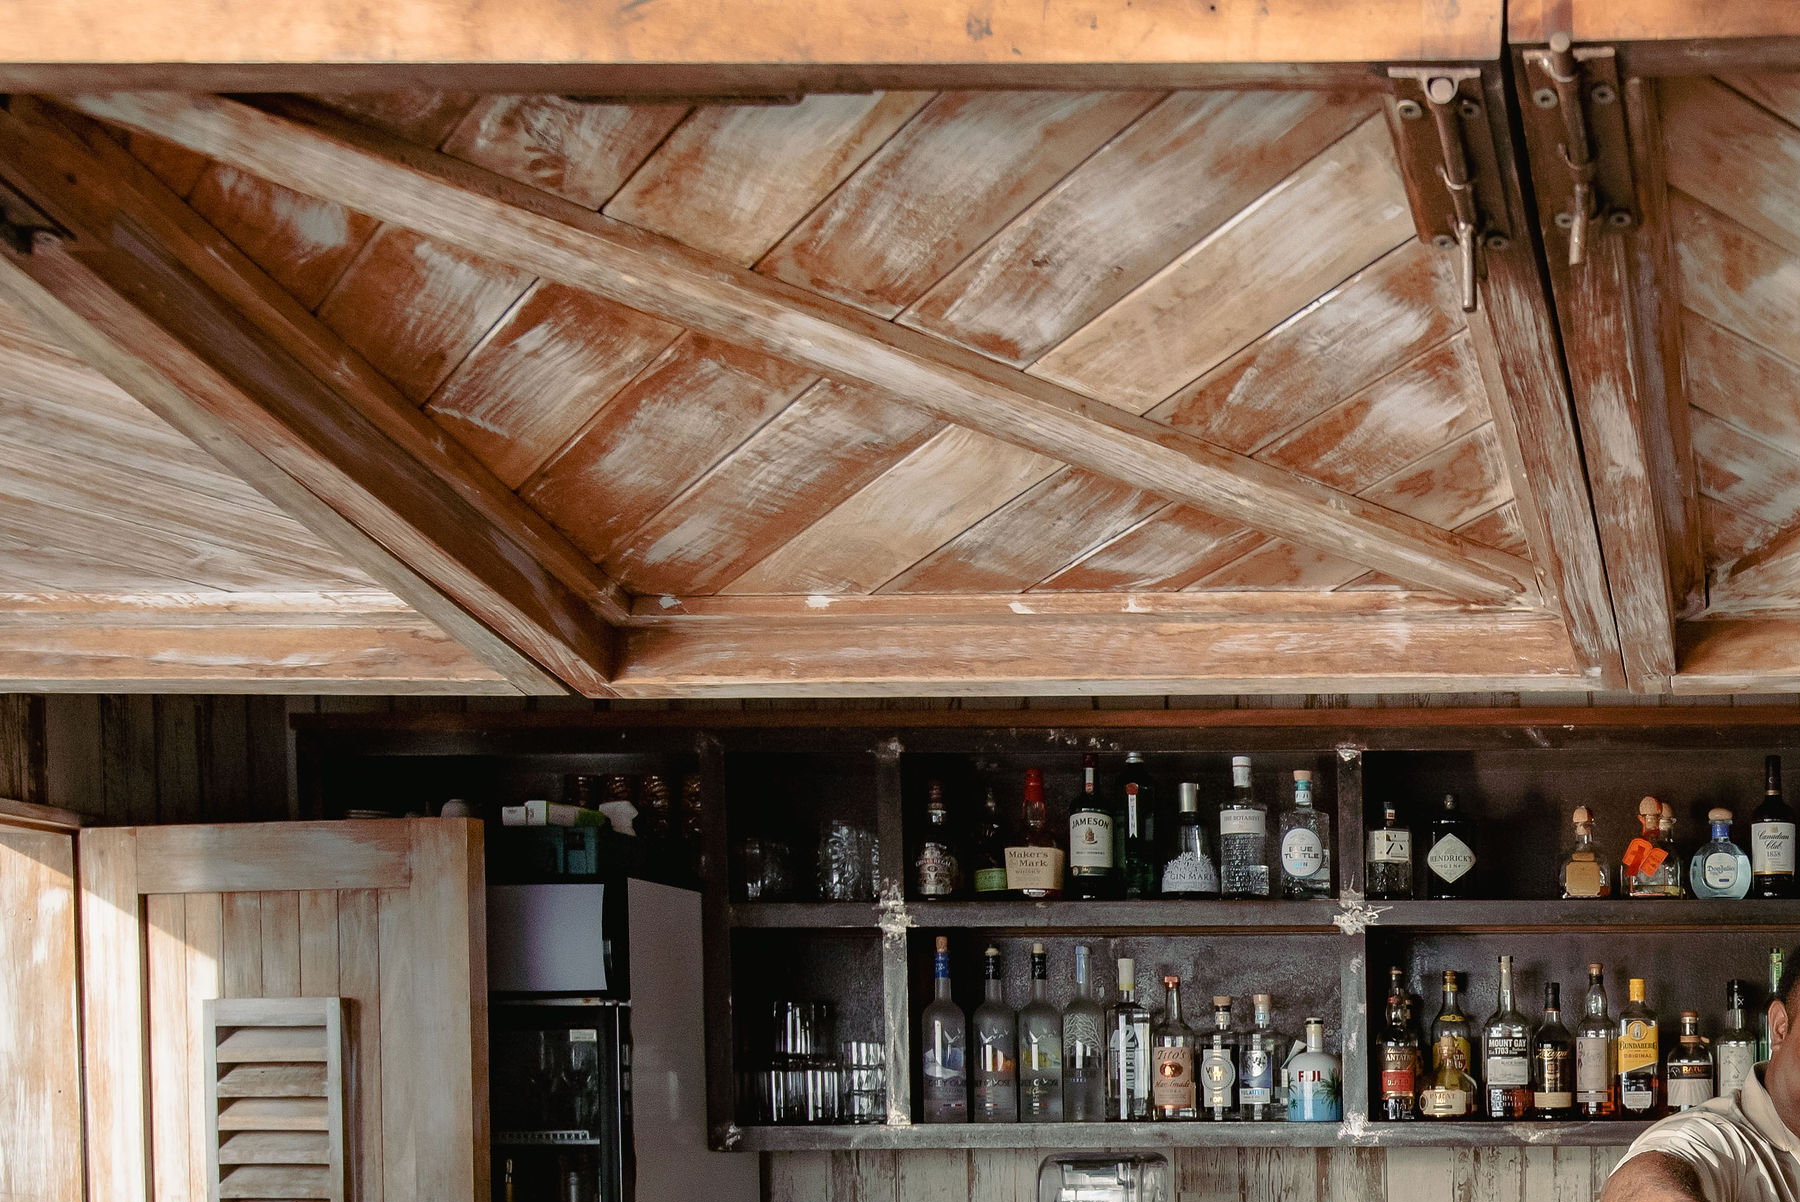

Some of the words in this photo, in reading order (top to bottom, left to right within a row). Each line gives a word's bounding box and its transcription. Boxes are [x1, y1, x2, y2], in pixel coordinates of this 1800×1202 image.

[1071, 817, 1110, 830] JAMESON
[1757, 830, 1790, 840] Canadian
[1764, 841, 1784, 850] Club
[1009, 851, 1049, 859] Maker's
[1018, 859, 1049, 868] Mark
[1169, 873, 1187, 881] GIN
[1488, 1038, 1513, 1048] MOUNT
[1514, 1038, 1527, 1048] GAY
[1619, 1041, 1658, 1051] BUNDABERG
[1157, 1049, 1188, 1060] Tito's
[1495, 1047, 1509, 1055] 1703
